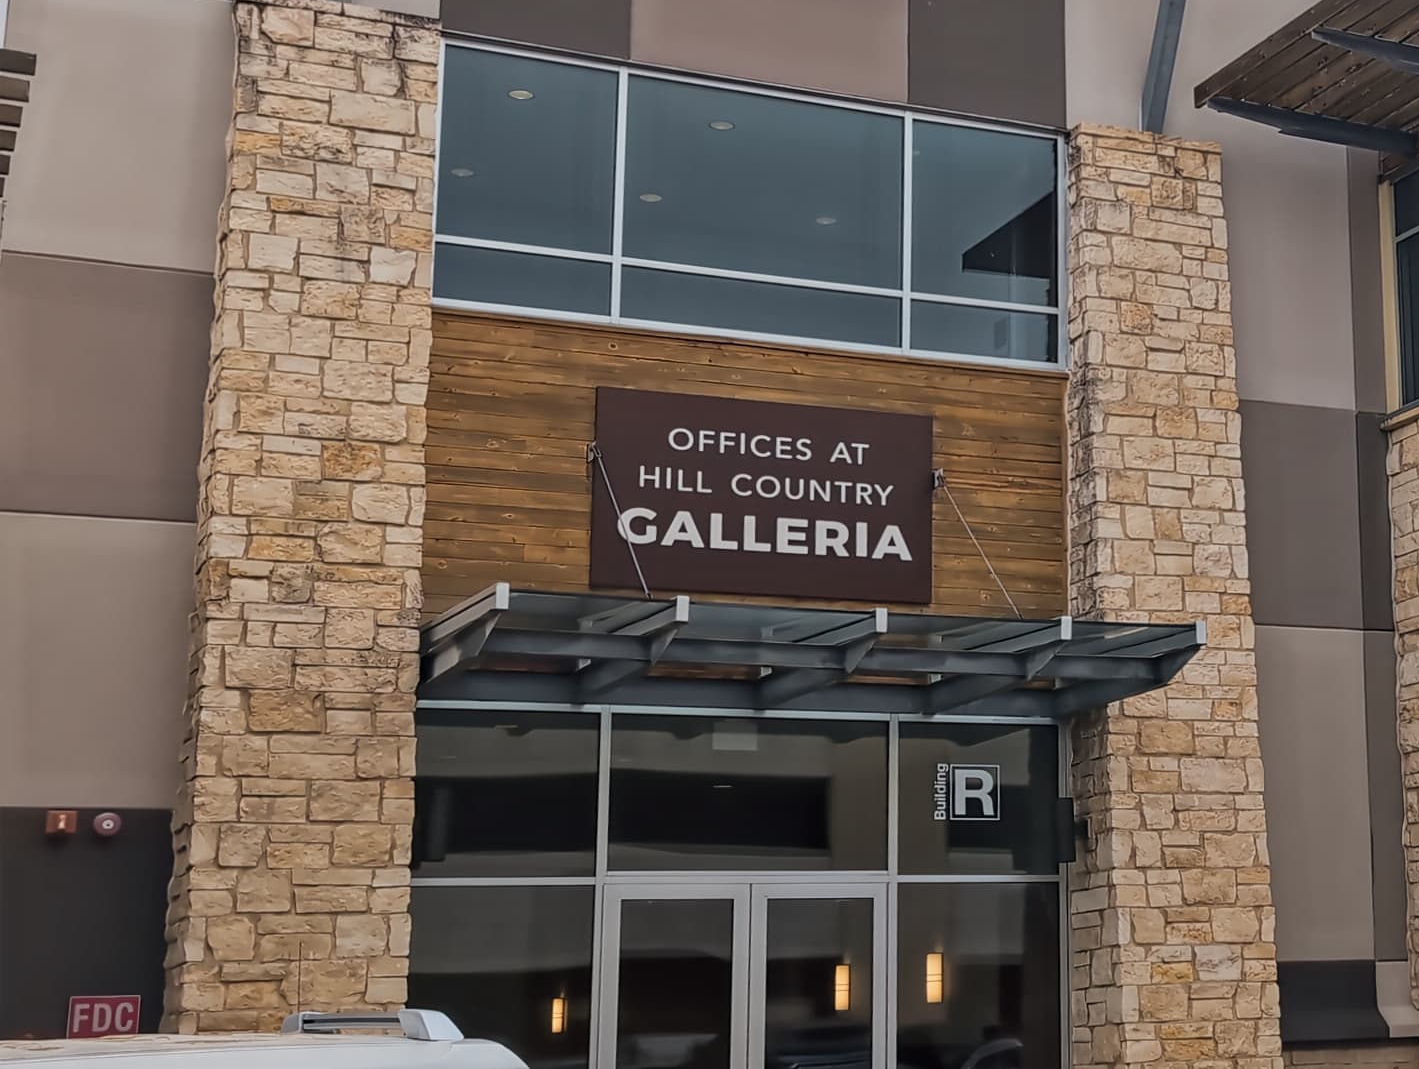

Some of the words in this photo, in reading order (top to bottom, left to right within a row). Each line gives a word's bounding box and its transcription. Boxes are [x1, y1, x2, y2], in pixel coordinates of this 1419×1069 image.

[668, 428, 812, 461] OFFICES
[829, 442, 870, 465] AT
[639, 465, 712, 494] HILL
[731, 473, 894, 506] COUNTRY
[617, 507, 913, 561] GALLERIA
[934, 763, 948, 820] Building
[955, 769, 995, 816] R
[73, 1002, 134, 1033] FDC
